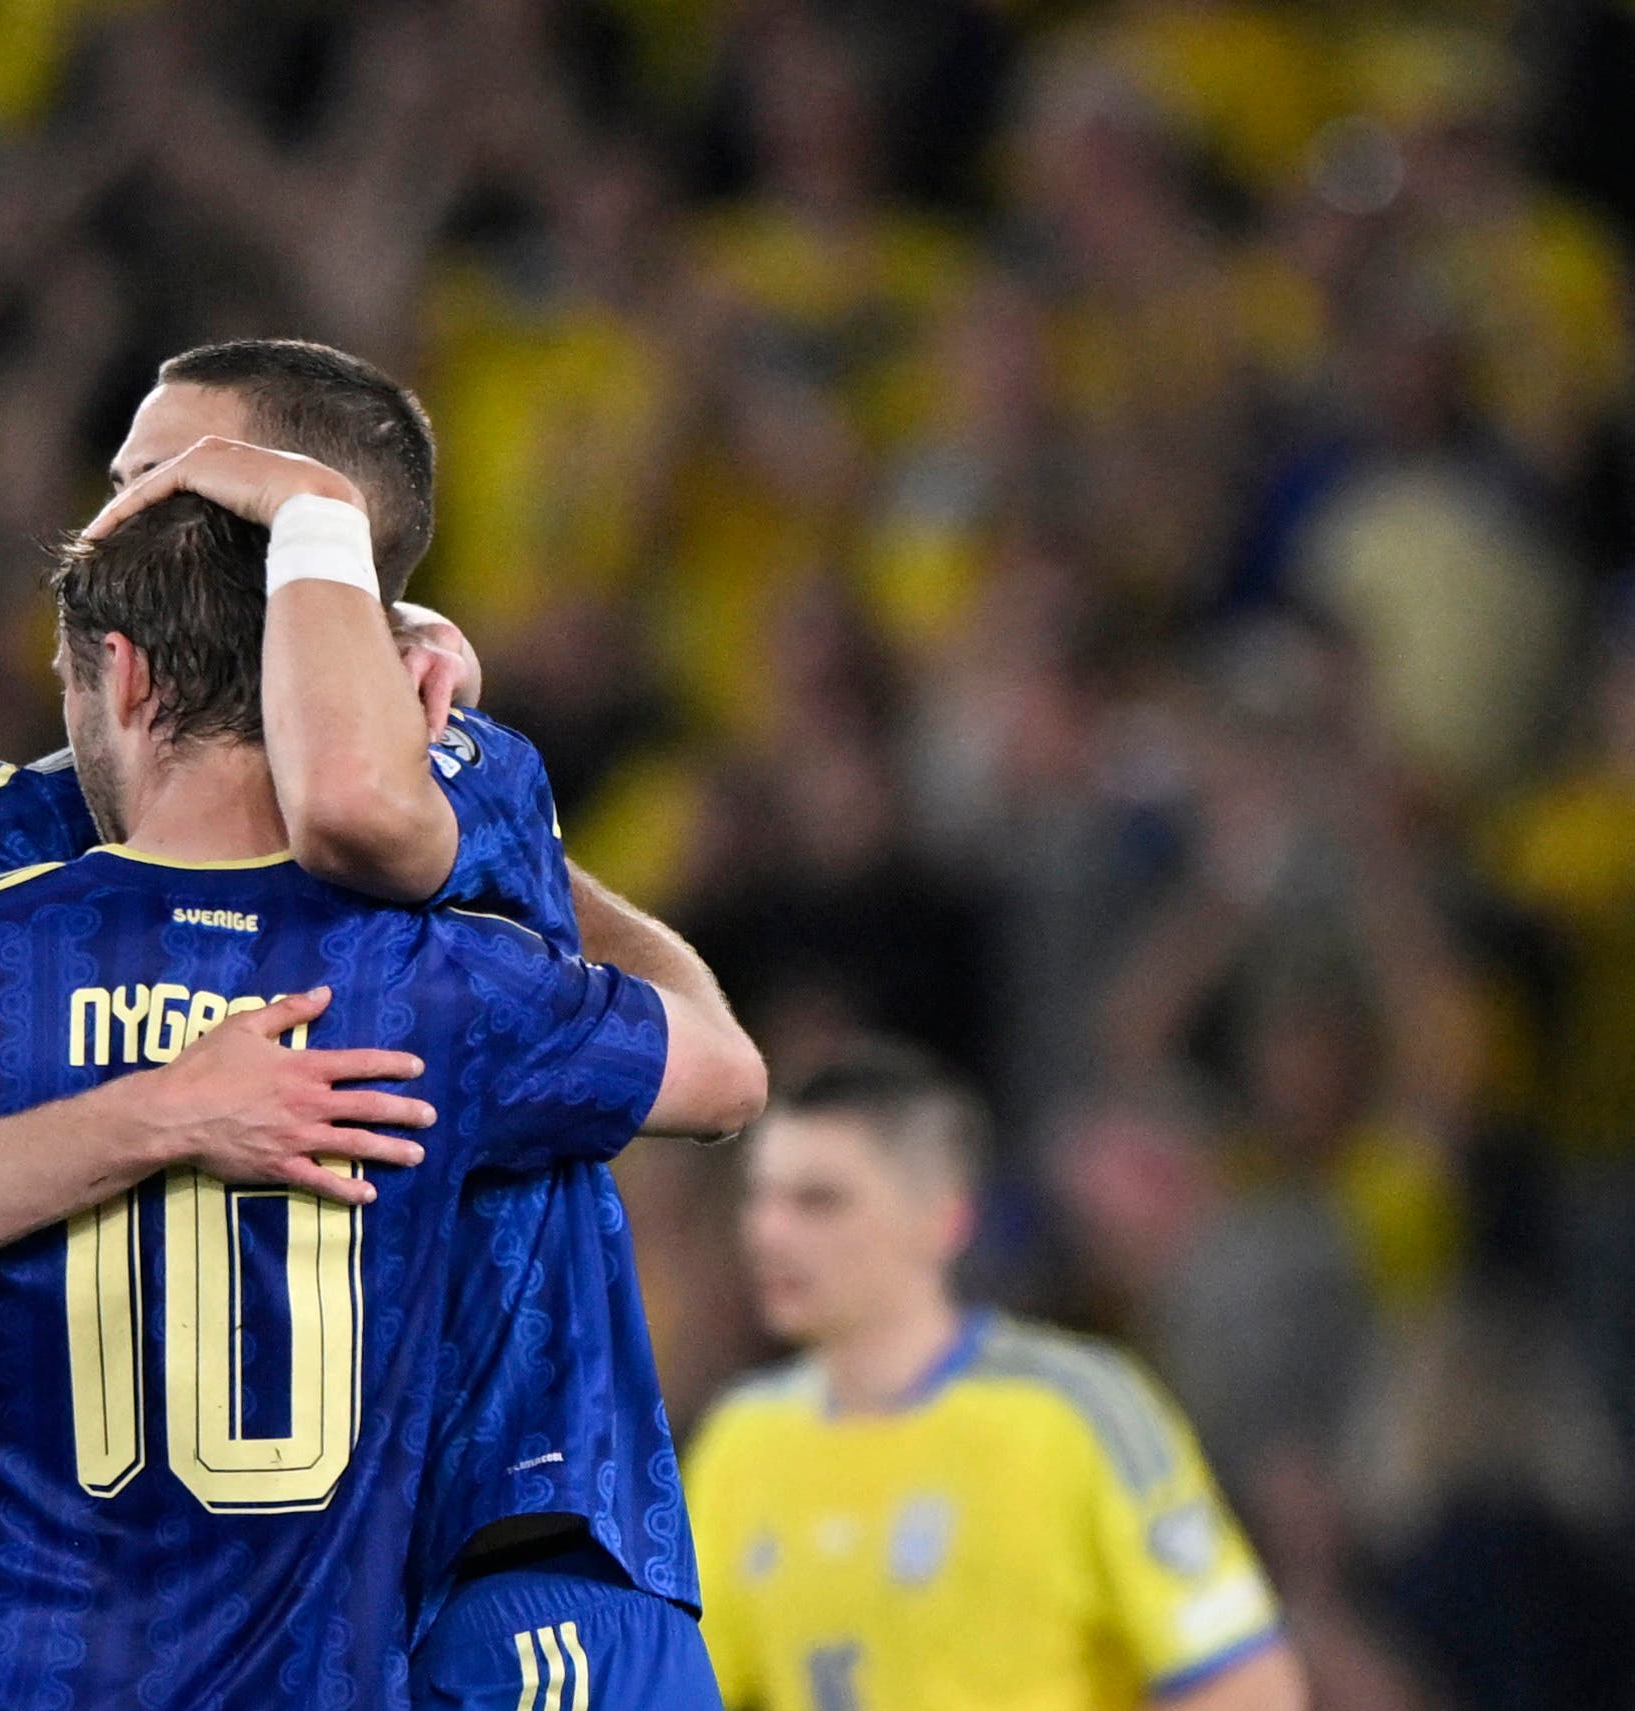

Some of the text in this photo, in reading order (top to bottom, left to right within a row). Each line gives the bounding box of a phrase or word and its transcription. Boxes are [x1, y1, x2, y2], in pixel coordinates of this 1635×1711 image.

[172, 906, 259, 932] SVERIGE
[69, 982, 309, 1067] NYGR
[65, 1157, 364, 1514] 10
